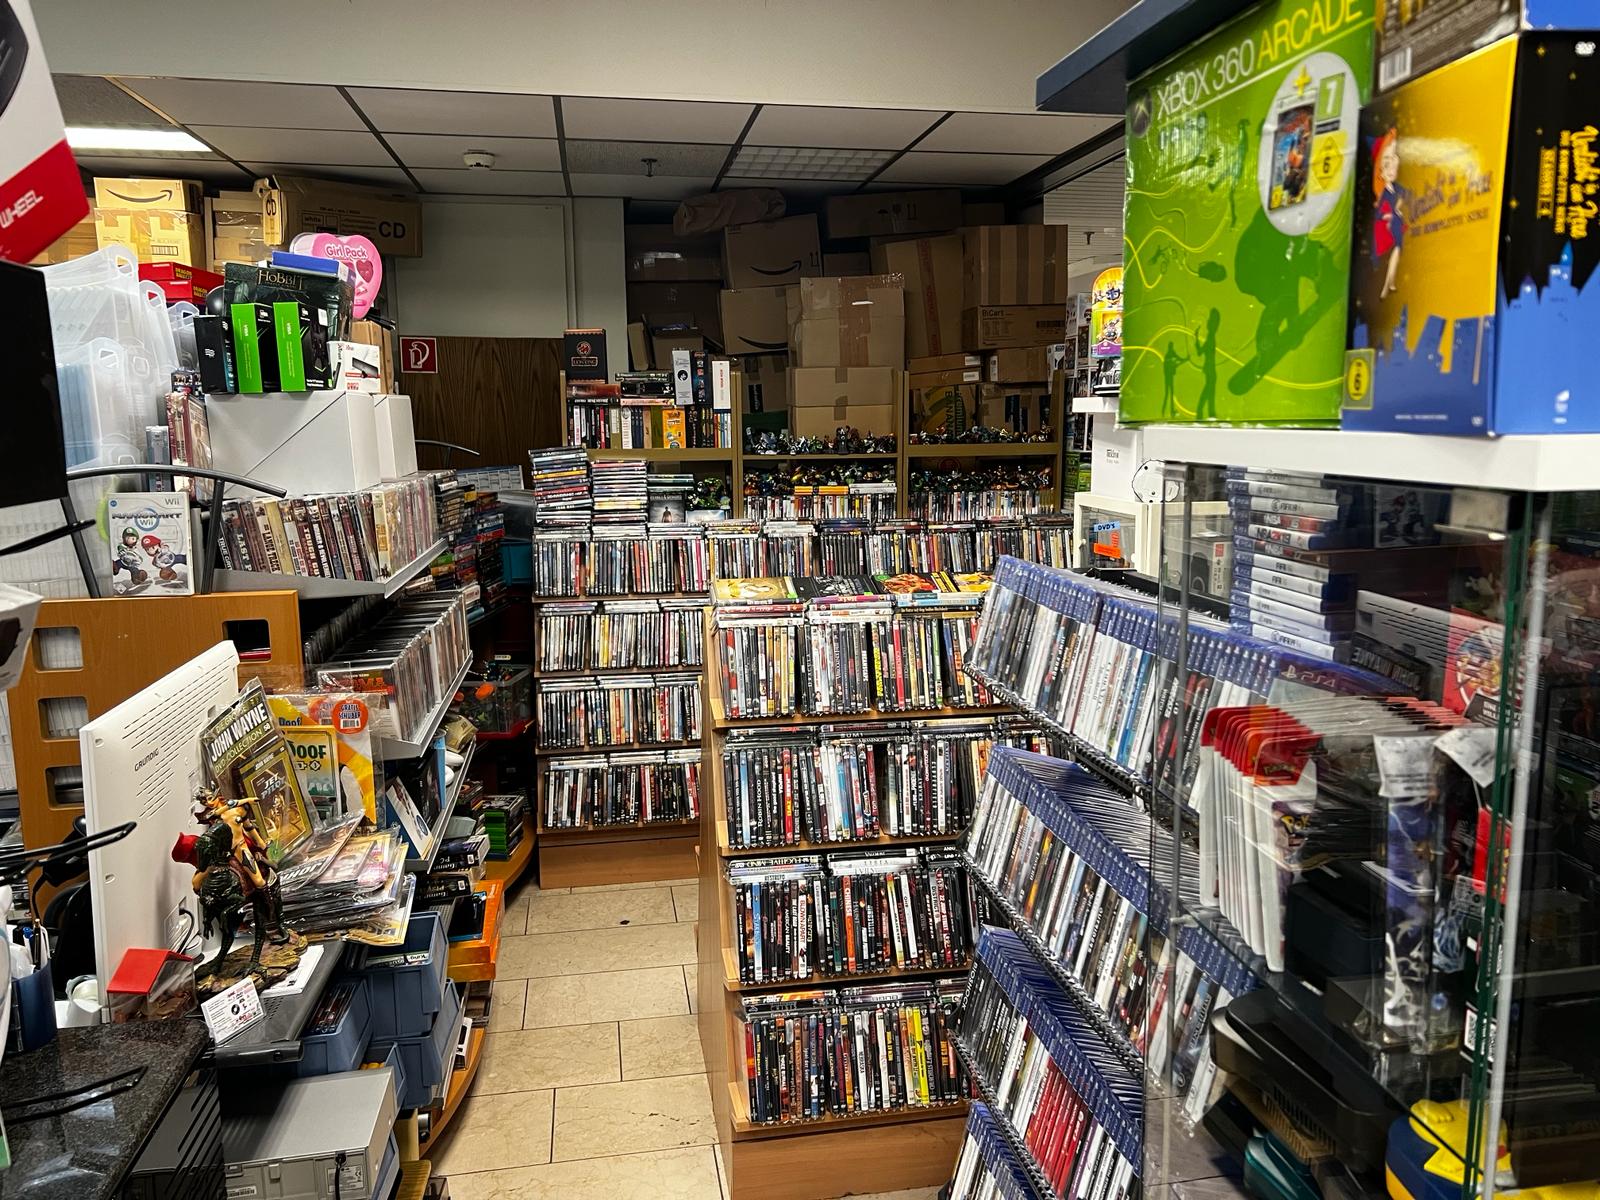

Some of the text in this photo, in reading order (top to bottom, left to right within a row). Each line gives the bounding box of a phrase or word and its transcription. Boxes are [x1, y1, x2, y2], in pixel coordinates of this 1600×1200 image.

[1157, 63, 1209, 120] XBOX
[1212, 38, 1255, 91] 360
[1257, 0, 1363, 68] ARCADE
[1322, 157, 1331, 174] 6
[0, 190, 44, 228] WHEEL
[266, 198, 276, 216] CD
[378, 221, 406, 238] CD
[326, 245, 367, 258] Girl Pack
[1257, 528, 1271, 541] NBA
[236, 534, 248, 560] LAST
[1276, 562, 1286, 570] FIFA
[1272, 576, 1282, 584] FIFA
[1301, 671, 1336, 689] PS4
[210, 703, 267, 762] JOHN WAYNE
[134, 747, 160, 772] GRUNDIG
[264, 773, 278, 790] JET
[962, 962, 978, 1010] BIOSHOCK
